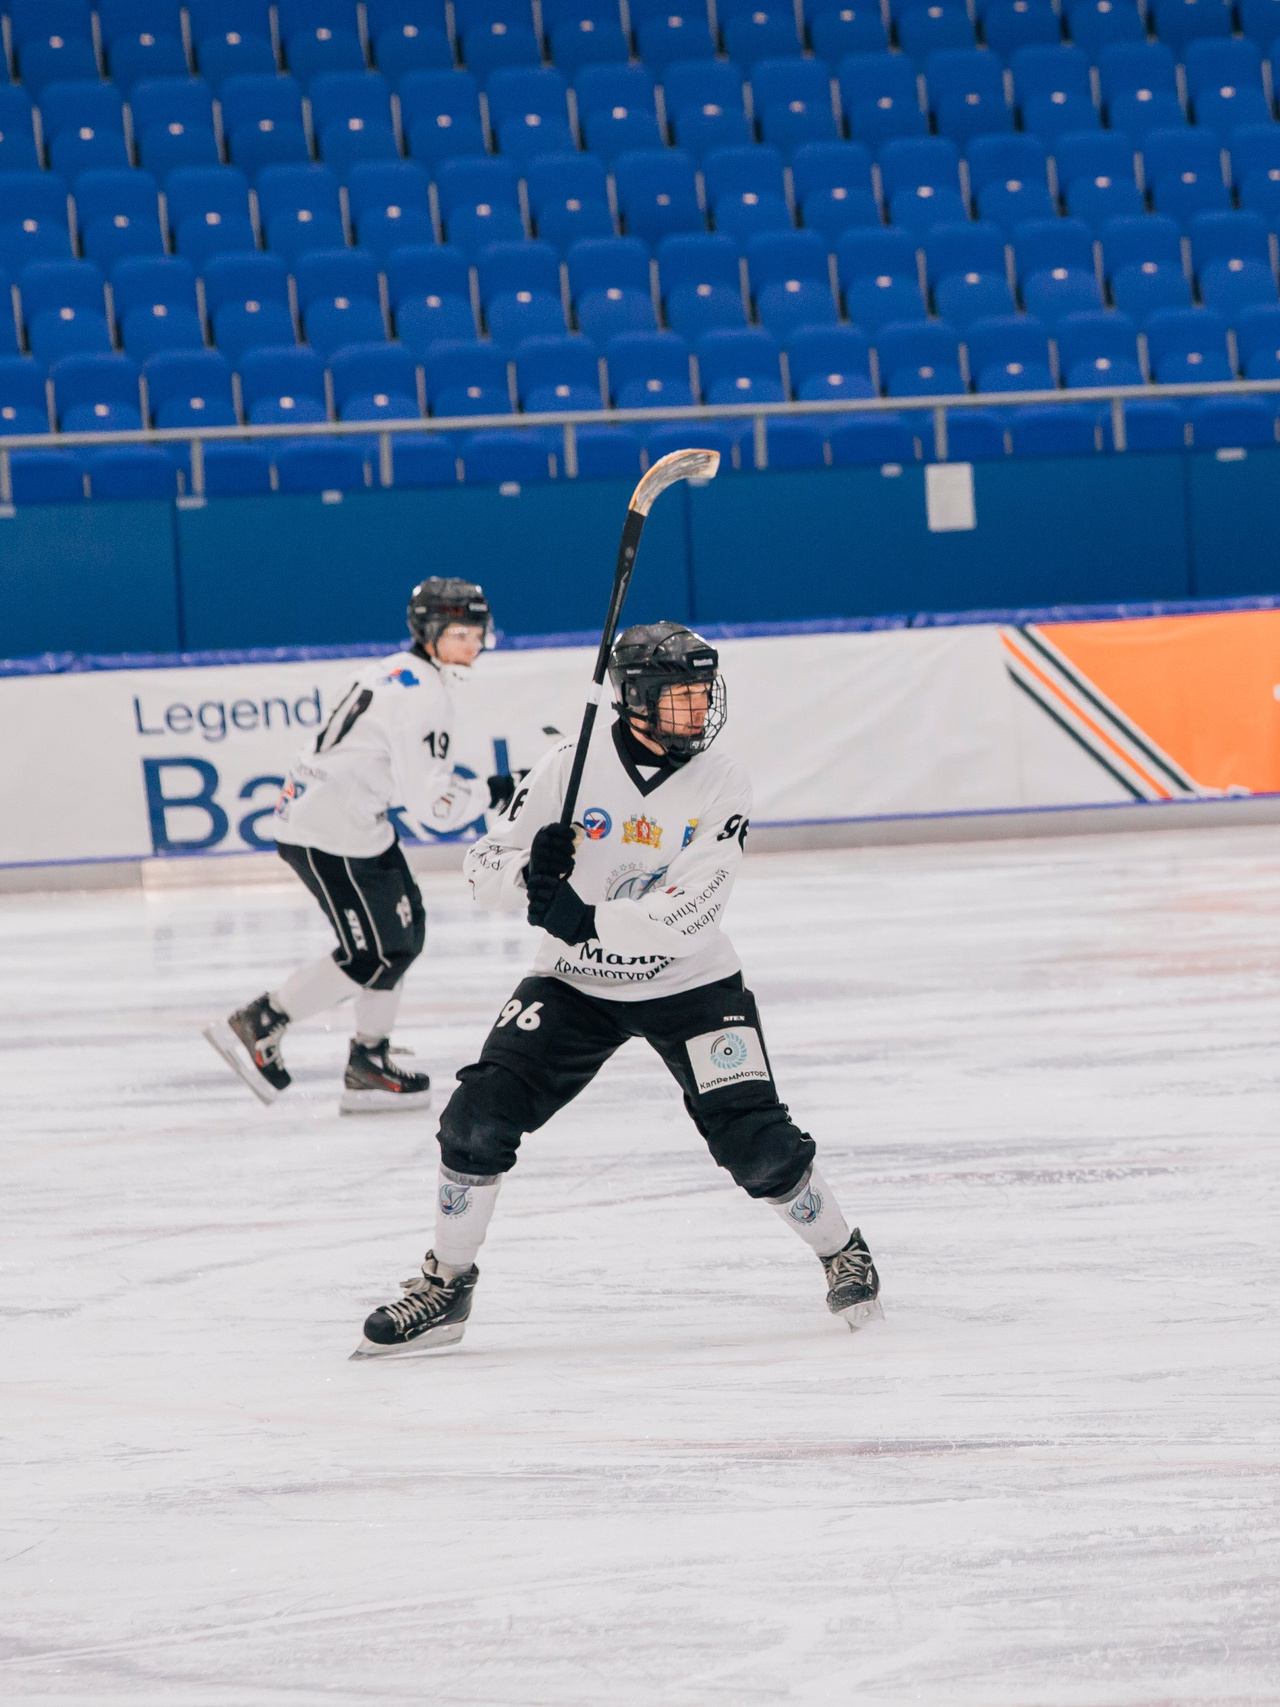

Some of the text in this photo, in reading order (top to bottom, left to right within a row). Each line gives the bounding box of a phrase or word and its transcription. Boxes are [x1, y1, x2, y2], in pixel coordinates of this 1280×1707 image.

[133, 685, 321, 742] Legend
[423, 730, 450, 759] 19
[648, 868, 730, 927] анцузский
[496, 999, 544, 1031] 96
